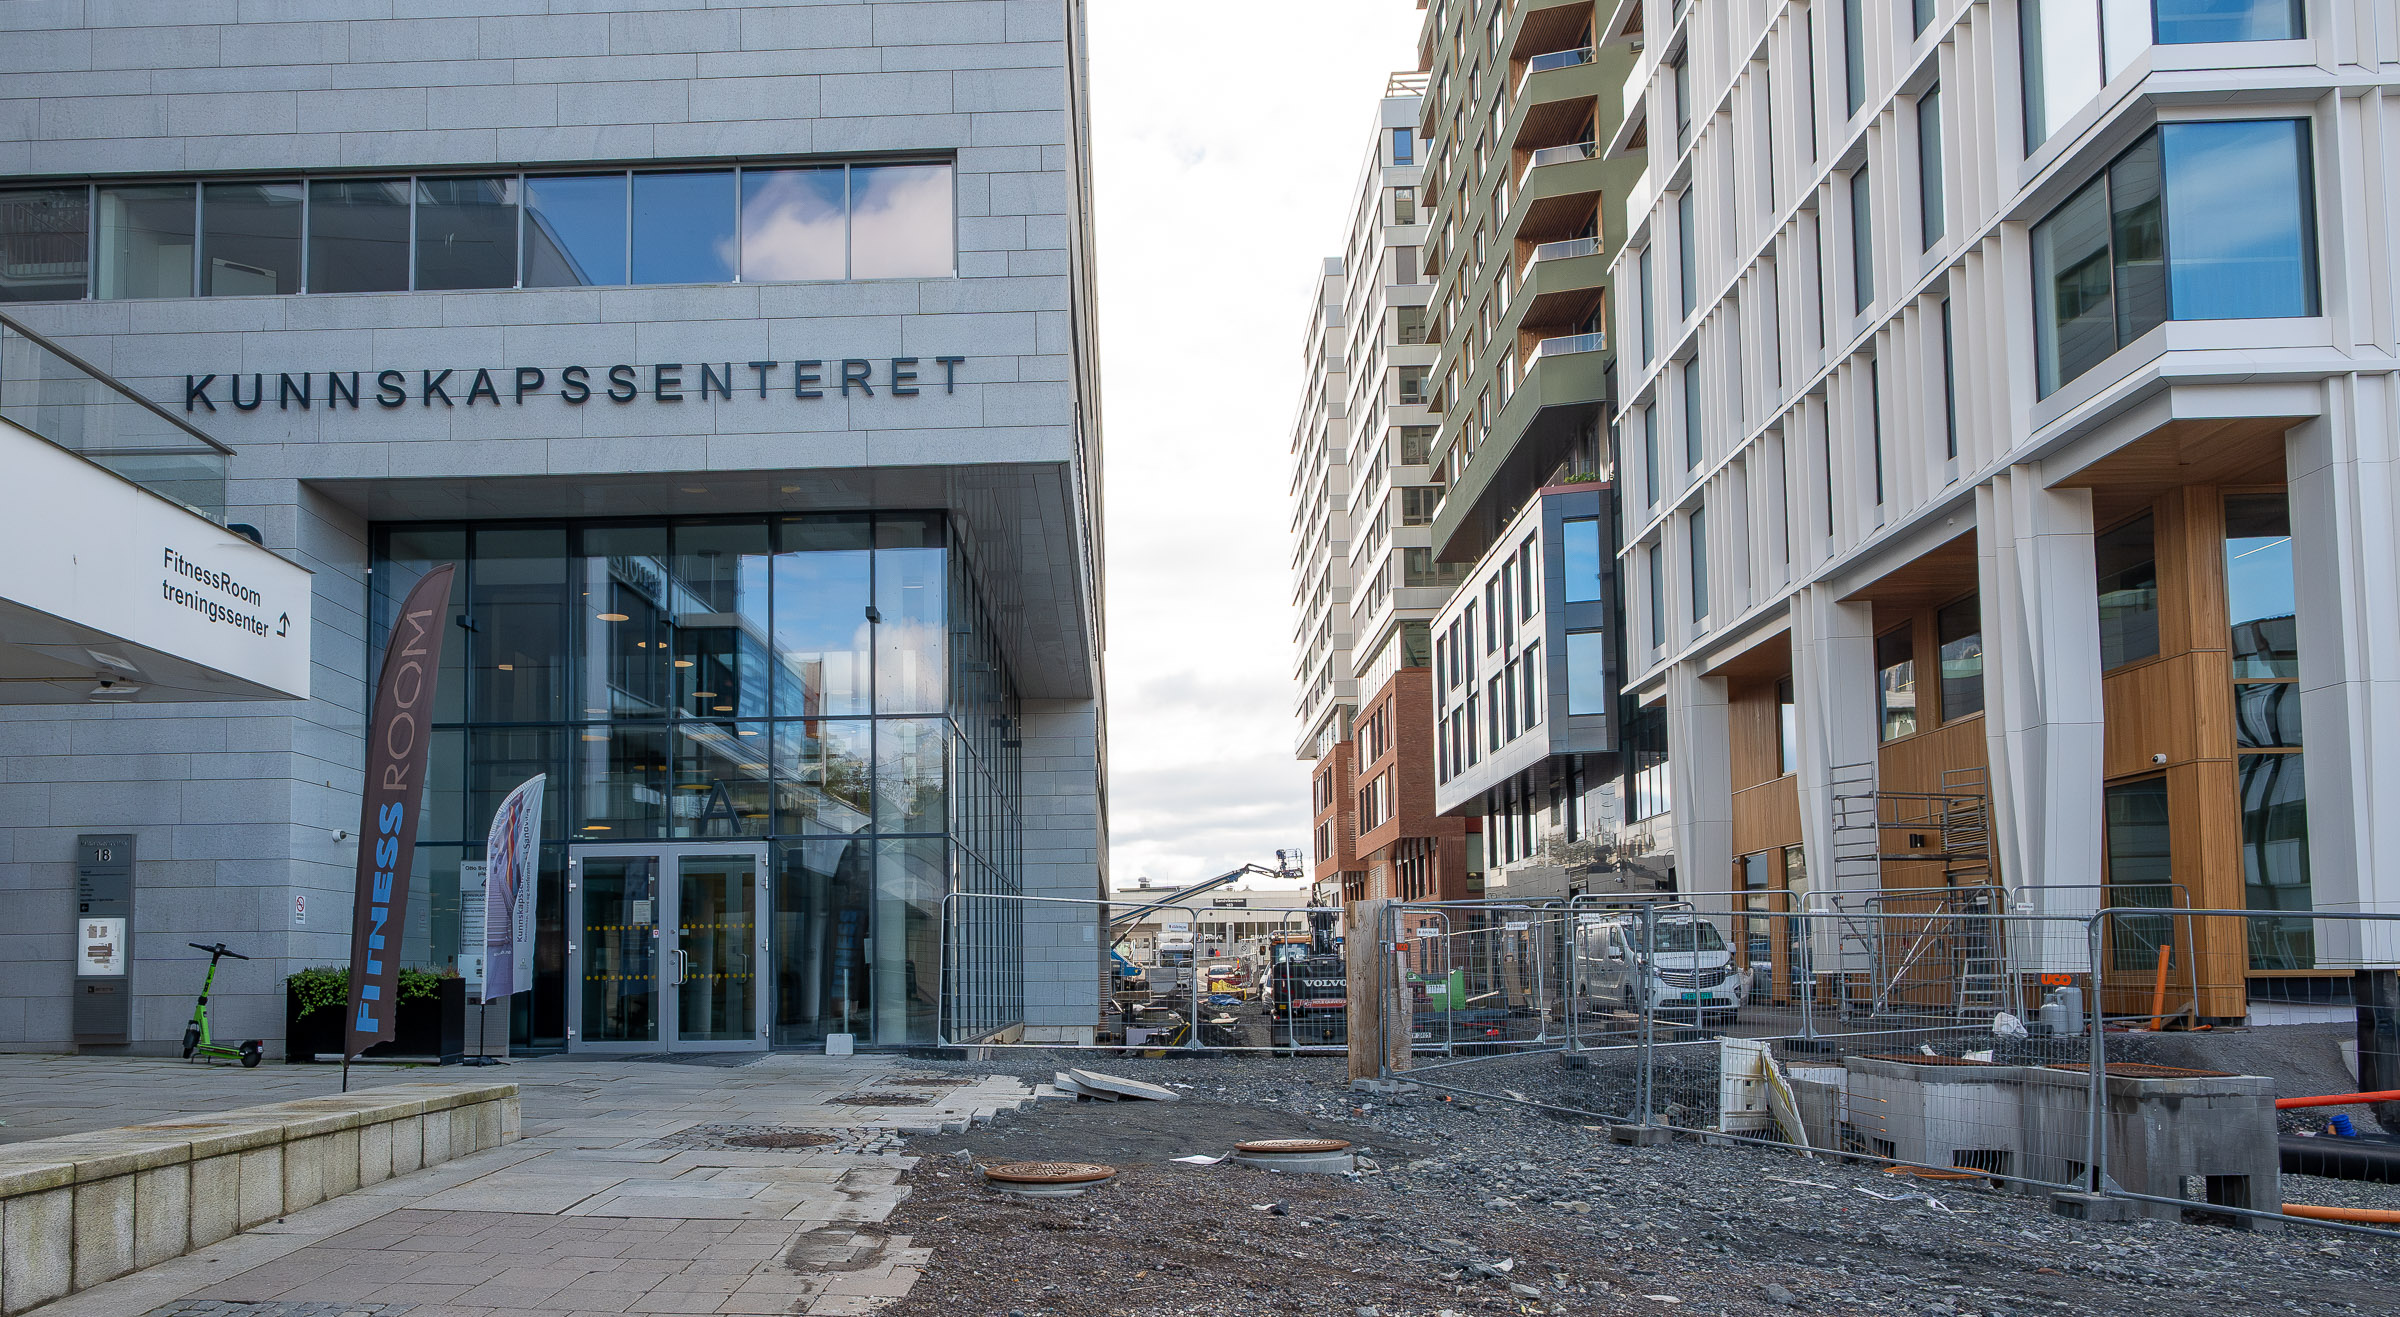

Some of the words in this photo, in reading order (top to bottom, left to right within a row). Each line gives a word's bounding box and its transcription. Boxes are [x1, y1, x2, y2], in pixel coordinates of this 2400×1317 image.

[184, 355, 965, 411] KUNNSKAPSSENTERET
[163, 546, 261, 607] FitnessRoom
[162, 579, 269, 638] treningssenter
[355, 801, 404, 1033] FITNESS
[383, 609, 433, 791] ROOM
[701, 780, 743, 833] A
[94, 848, 112, 862] 18
[1303, 979, 1347, 987] VOLVO
[2041, 974, 2072, 986] UCO
